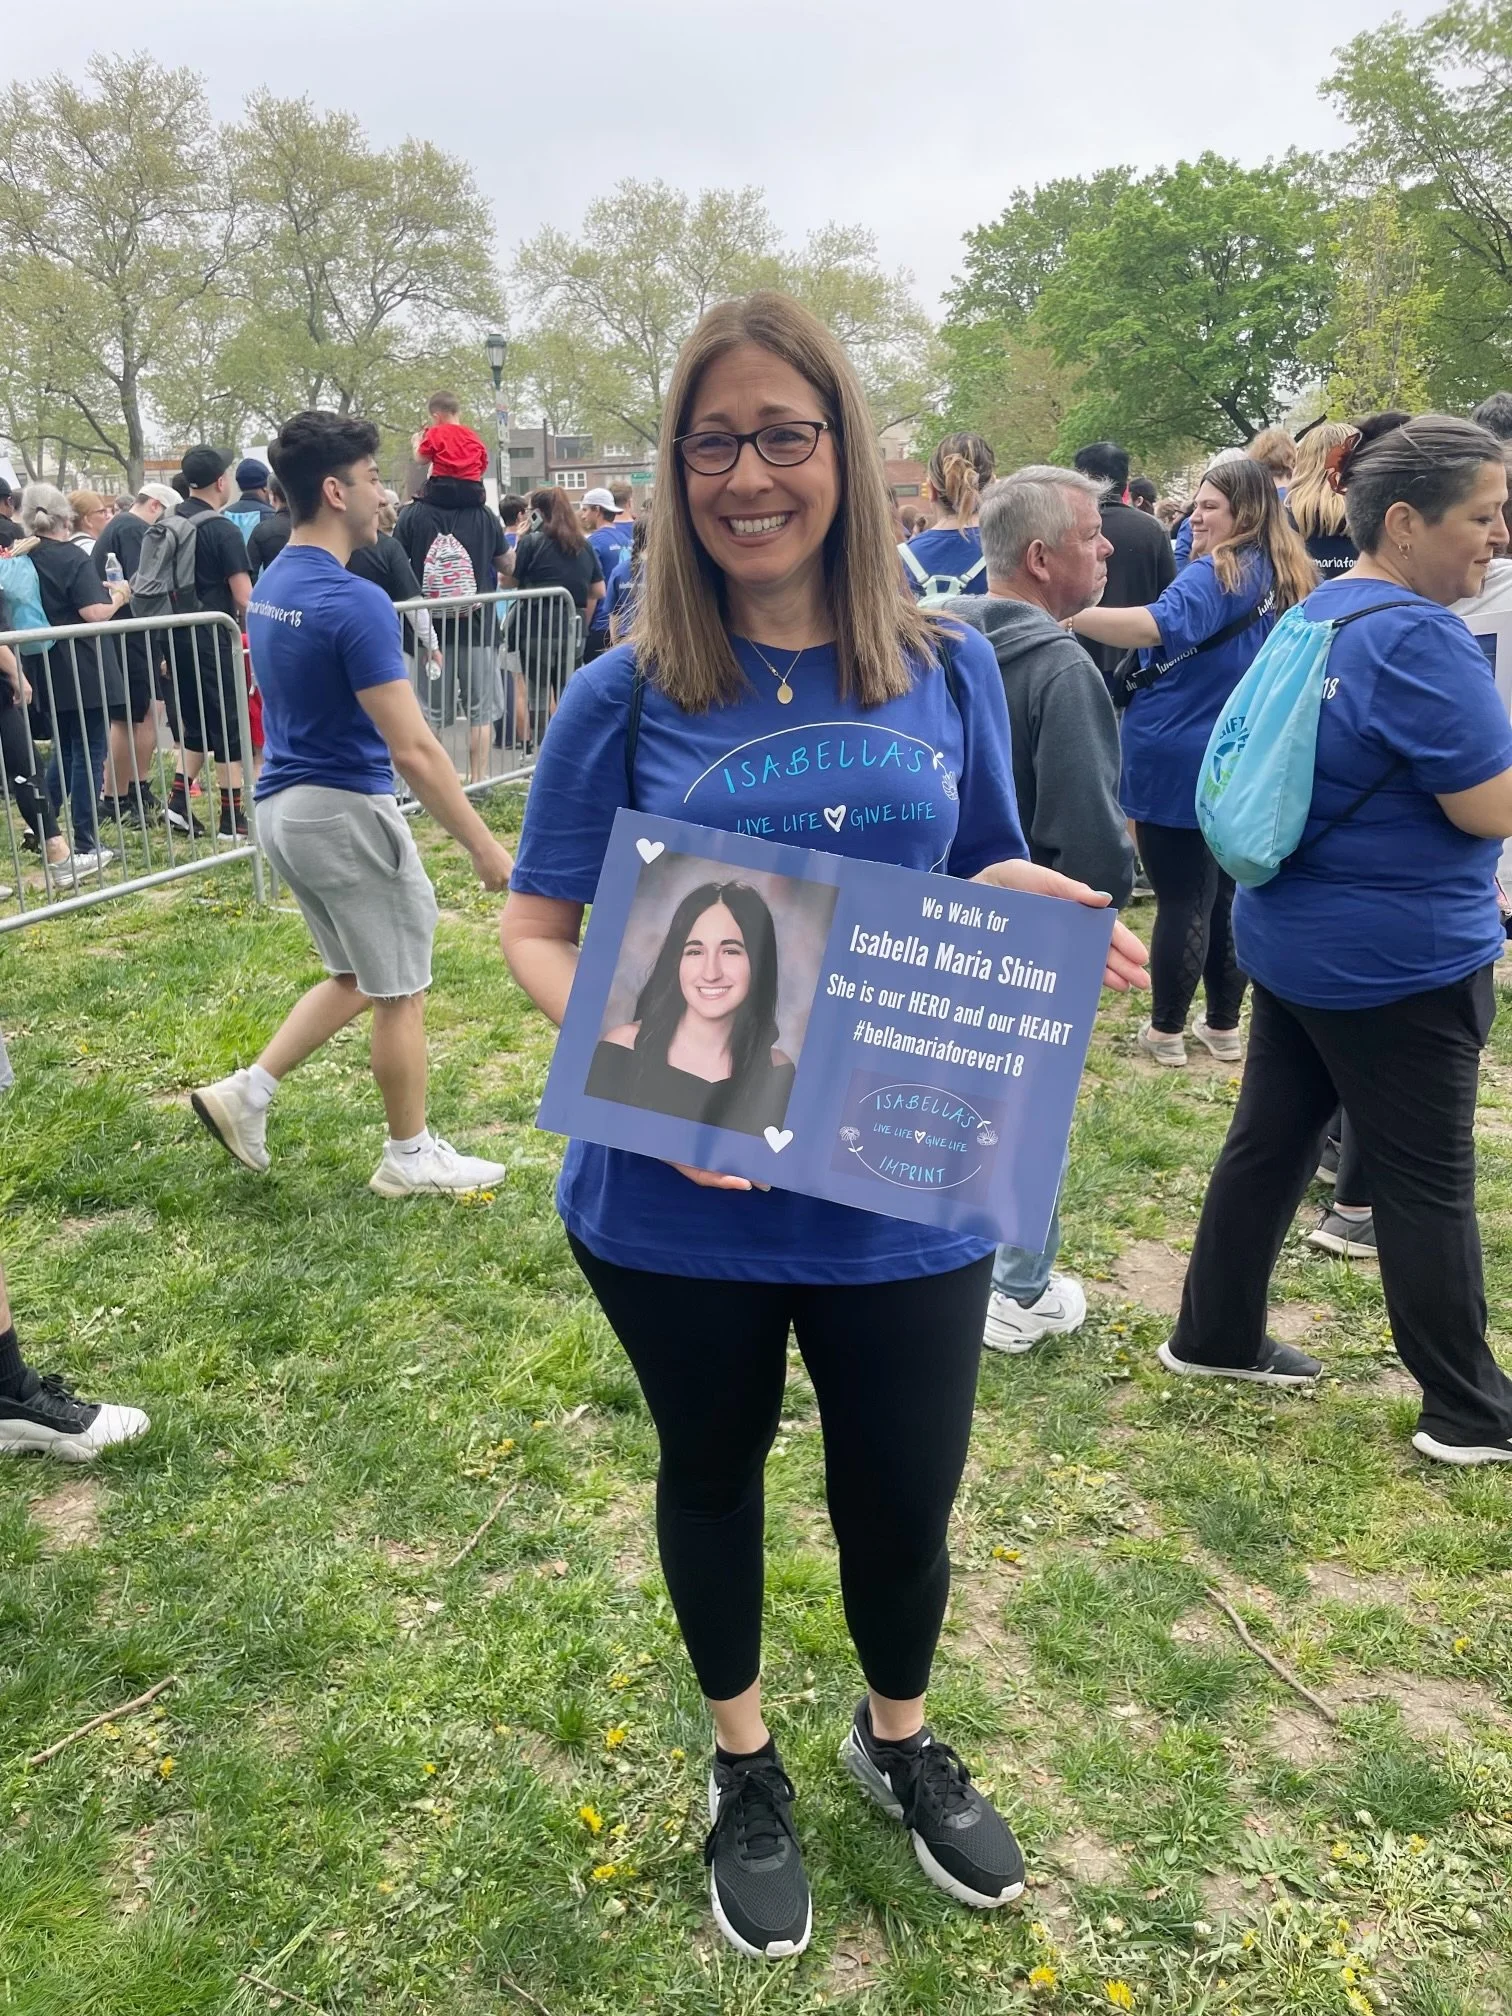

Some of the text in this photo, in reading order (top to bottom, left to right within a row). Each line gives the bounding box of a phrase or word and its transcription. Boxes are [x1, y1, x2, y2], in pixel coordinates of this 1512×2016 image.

[1322, 677, 1340, 700] 18
[723, 739, 925, 794] ISABELLA'S
[737, 802, 937, 835] LIVE LIFE GIVE LIFE
[921, 897, 1009, 933] We Walk for
[849, 924, 1057, 994] Isabella Maria Shinn
[827, 973, 1073, 1046] She is our HERO and our HEART
[852, 1019, 1025, 1078] #bellamariaforever18
[876, 1093, 975, 1128] ISABELLA'S
[873, 1123, 968, 1153] LIVE LIFE GIVE LIFE
[879, 1155, 946, 1184] IMPRINT
